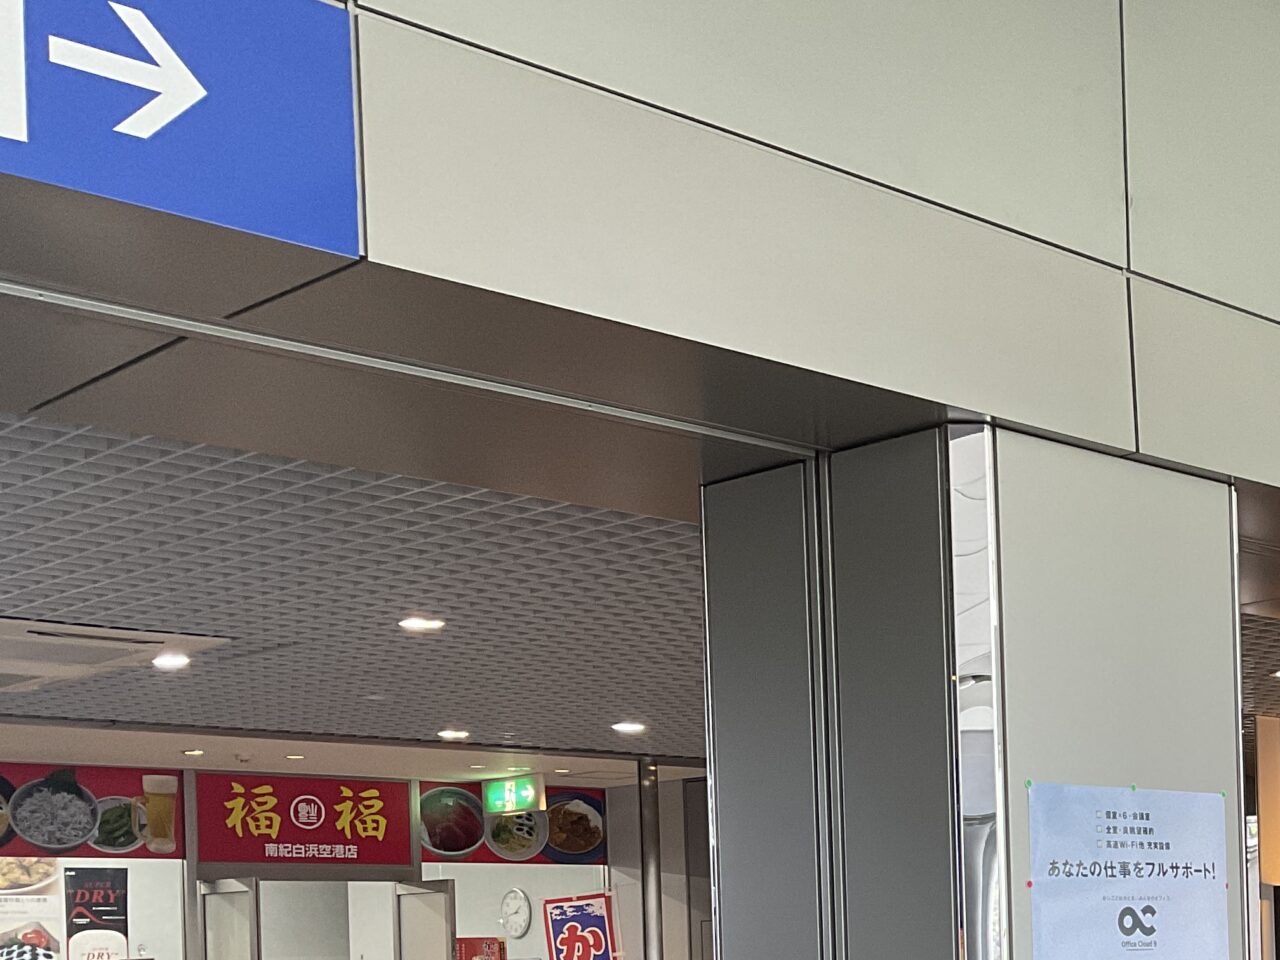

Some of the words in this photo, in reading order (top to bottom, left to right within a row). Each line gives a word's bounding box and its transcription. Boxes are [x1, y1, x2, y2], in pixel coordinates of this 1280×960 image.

[223, 781, 282, 840] 福
[333, 785, 388, 842] 福
[264, 843, 358, 859] 南紀白浜空港店
[1047, 859, 1217, 880] あなたの仕事をフルサポート!
